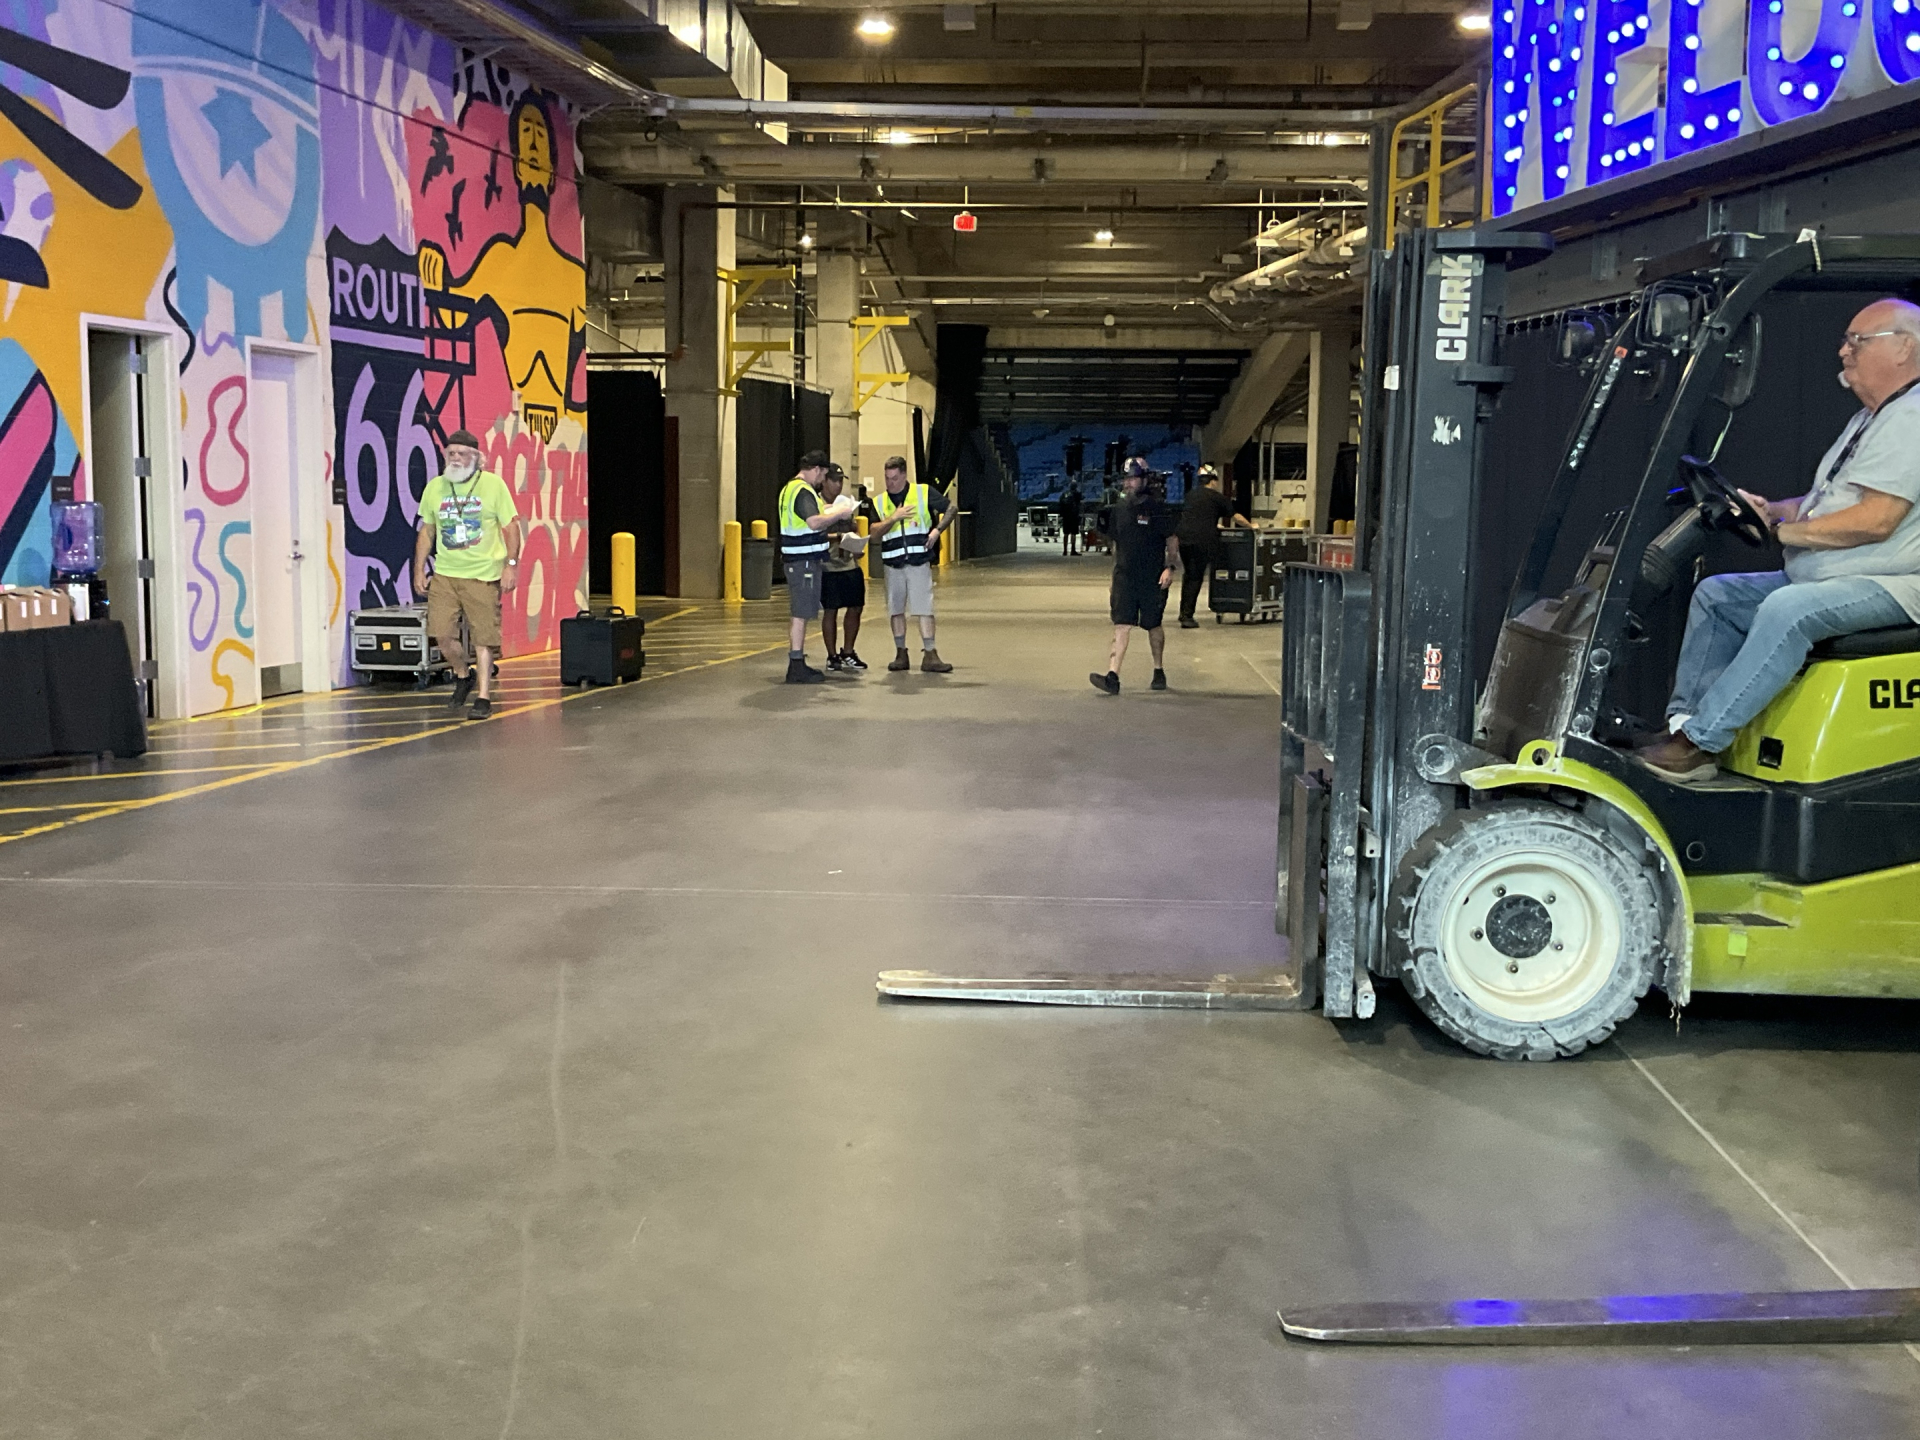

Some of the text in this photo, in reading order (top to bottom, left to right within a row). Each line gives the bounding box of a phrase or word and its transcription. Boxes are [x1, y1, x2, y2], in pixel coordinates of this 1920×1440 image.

[1436, 255, 1473, 361] CLARK
[344, 361, 439, 533] 66
[485, 431, 545, 522] OCK
[528, 413, 555, 446] TULSA
